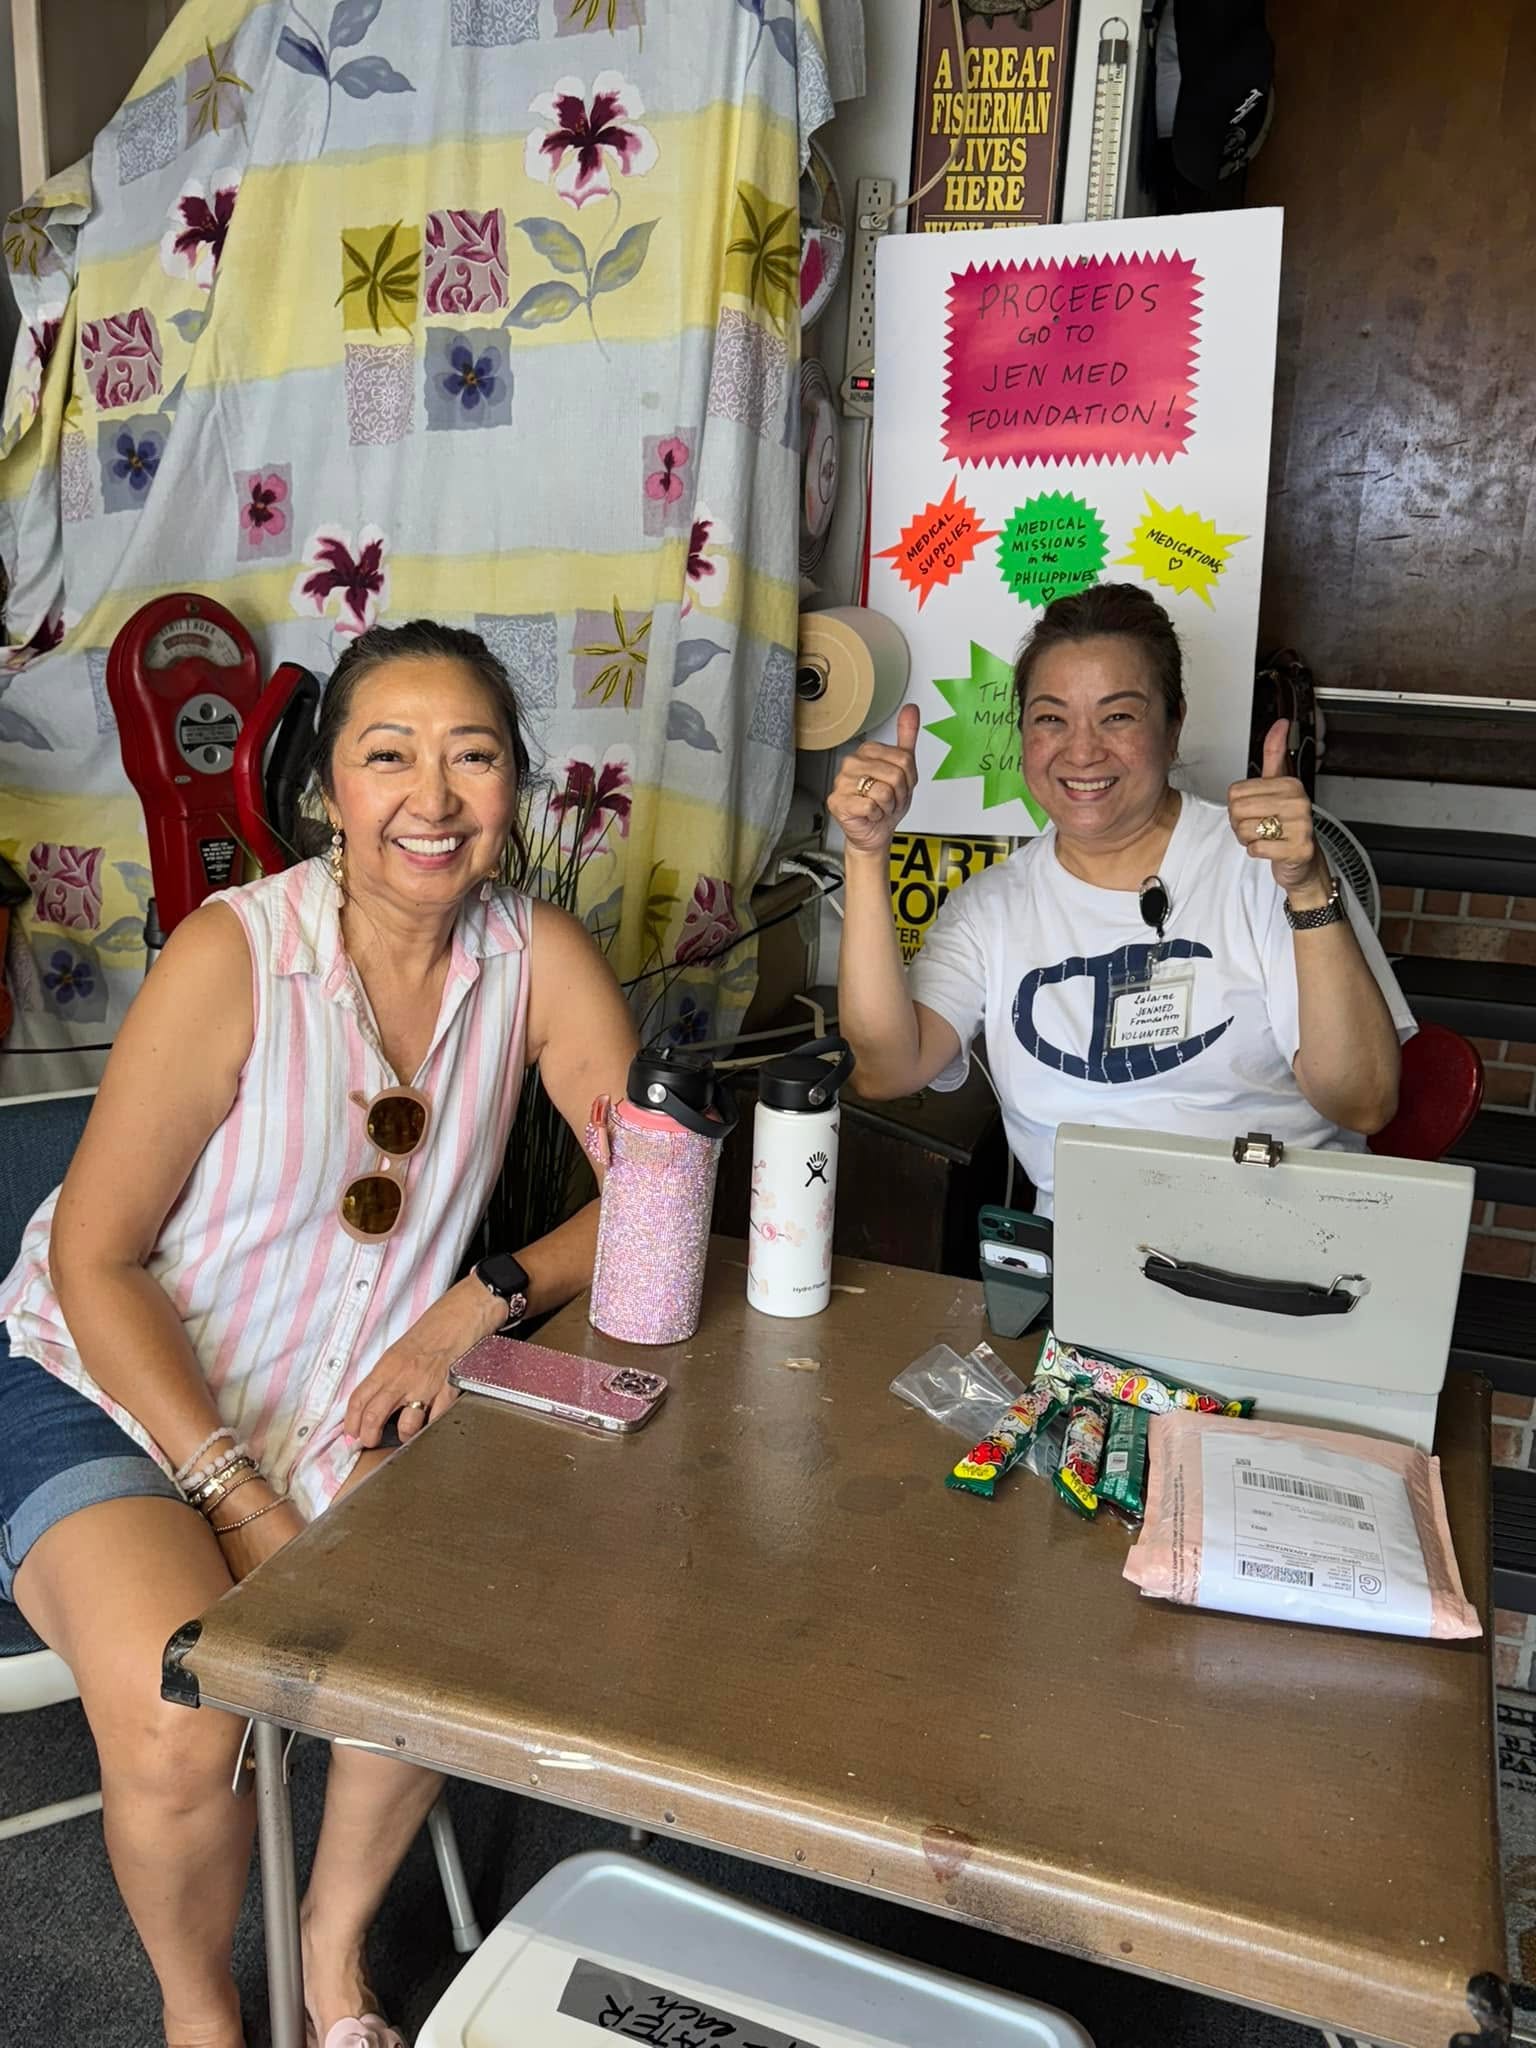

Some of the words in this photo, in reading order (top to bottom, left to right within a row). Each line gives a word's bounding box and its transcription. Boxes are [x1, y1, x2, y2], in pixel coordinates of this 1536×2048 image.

[933, 48, 953, 89] A
[964, 46, 1055, 89] GREAT
[930, 92, 1051, 135] FISHERMAN
[946, 137, 1027, 173] LIVES
[944, 175, 1025, 211] HERE
[978, 283, 1160, 320] PROCEEDS
[1018, 326, 1050, 345] GO
[1066, 324, 1095, 343] TO
[982, 363, 1048, 392] JEN
[1062, 362, 1128, 386] MED
[906, 513, 955, 561] MEDICAL
[1011, 534, 1087, 552] MISSIONS
[1016, 517, 1086, 536] MEDICAL
[918, 518, 971, 575] SUPPLIES
[1041, 551, 1058, 563] the
[1146, 528, 1223, 574] MEDICATIONS
[1014, 568, 1097, 586] PHILIPPINES
[1121, 1025, 1180, 1041] VOLUNTEER
